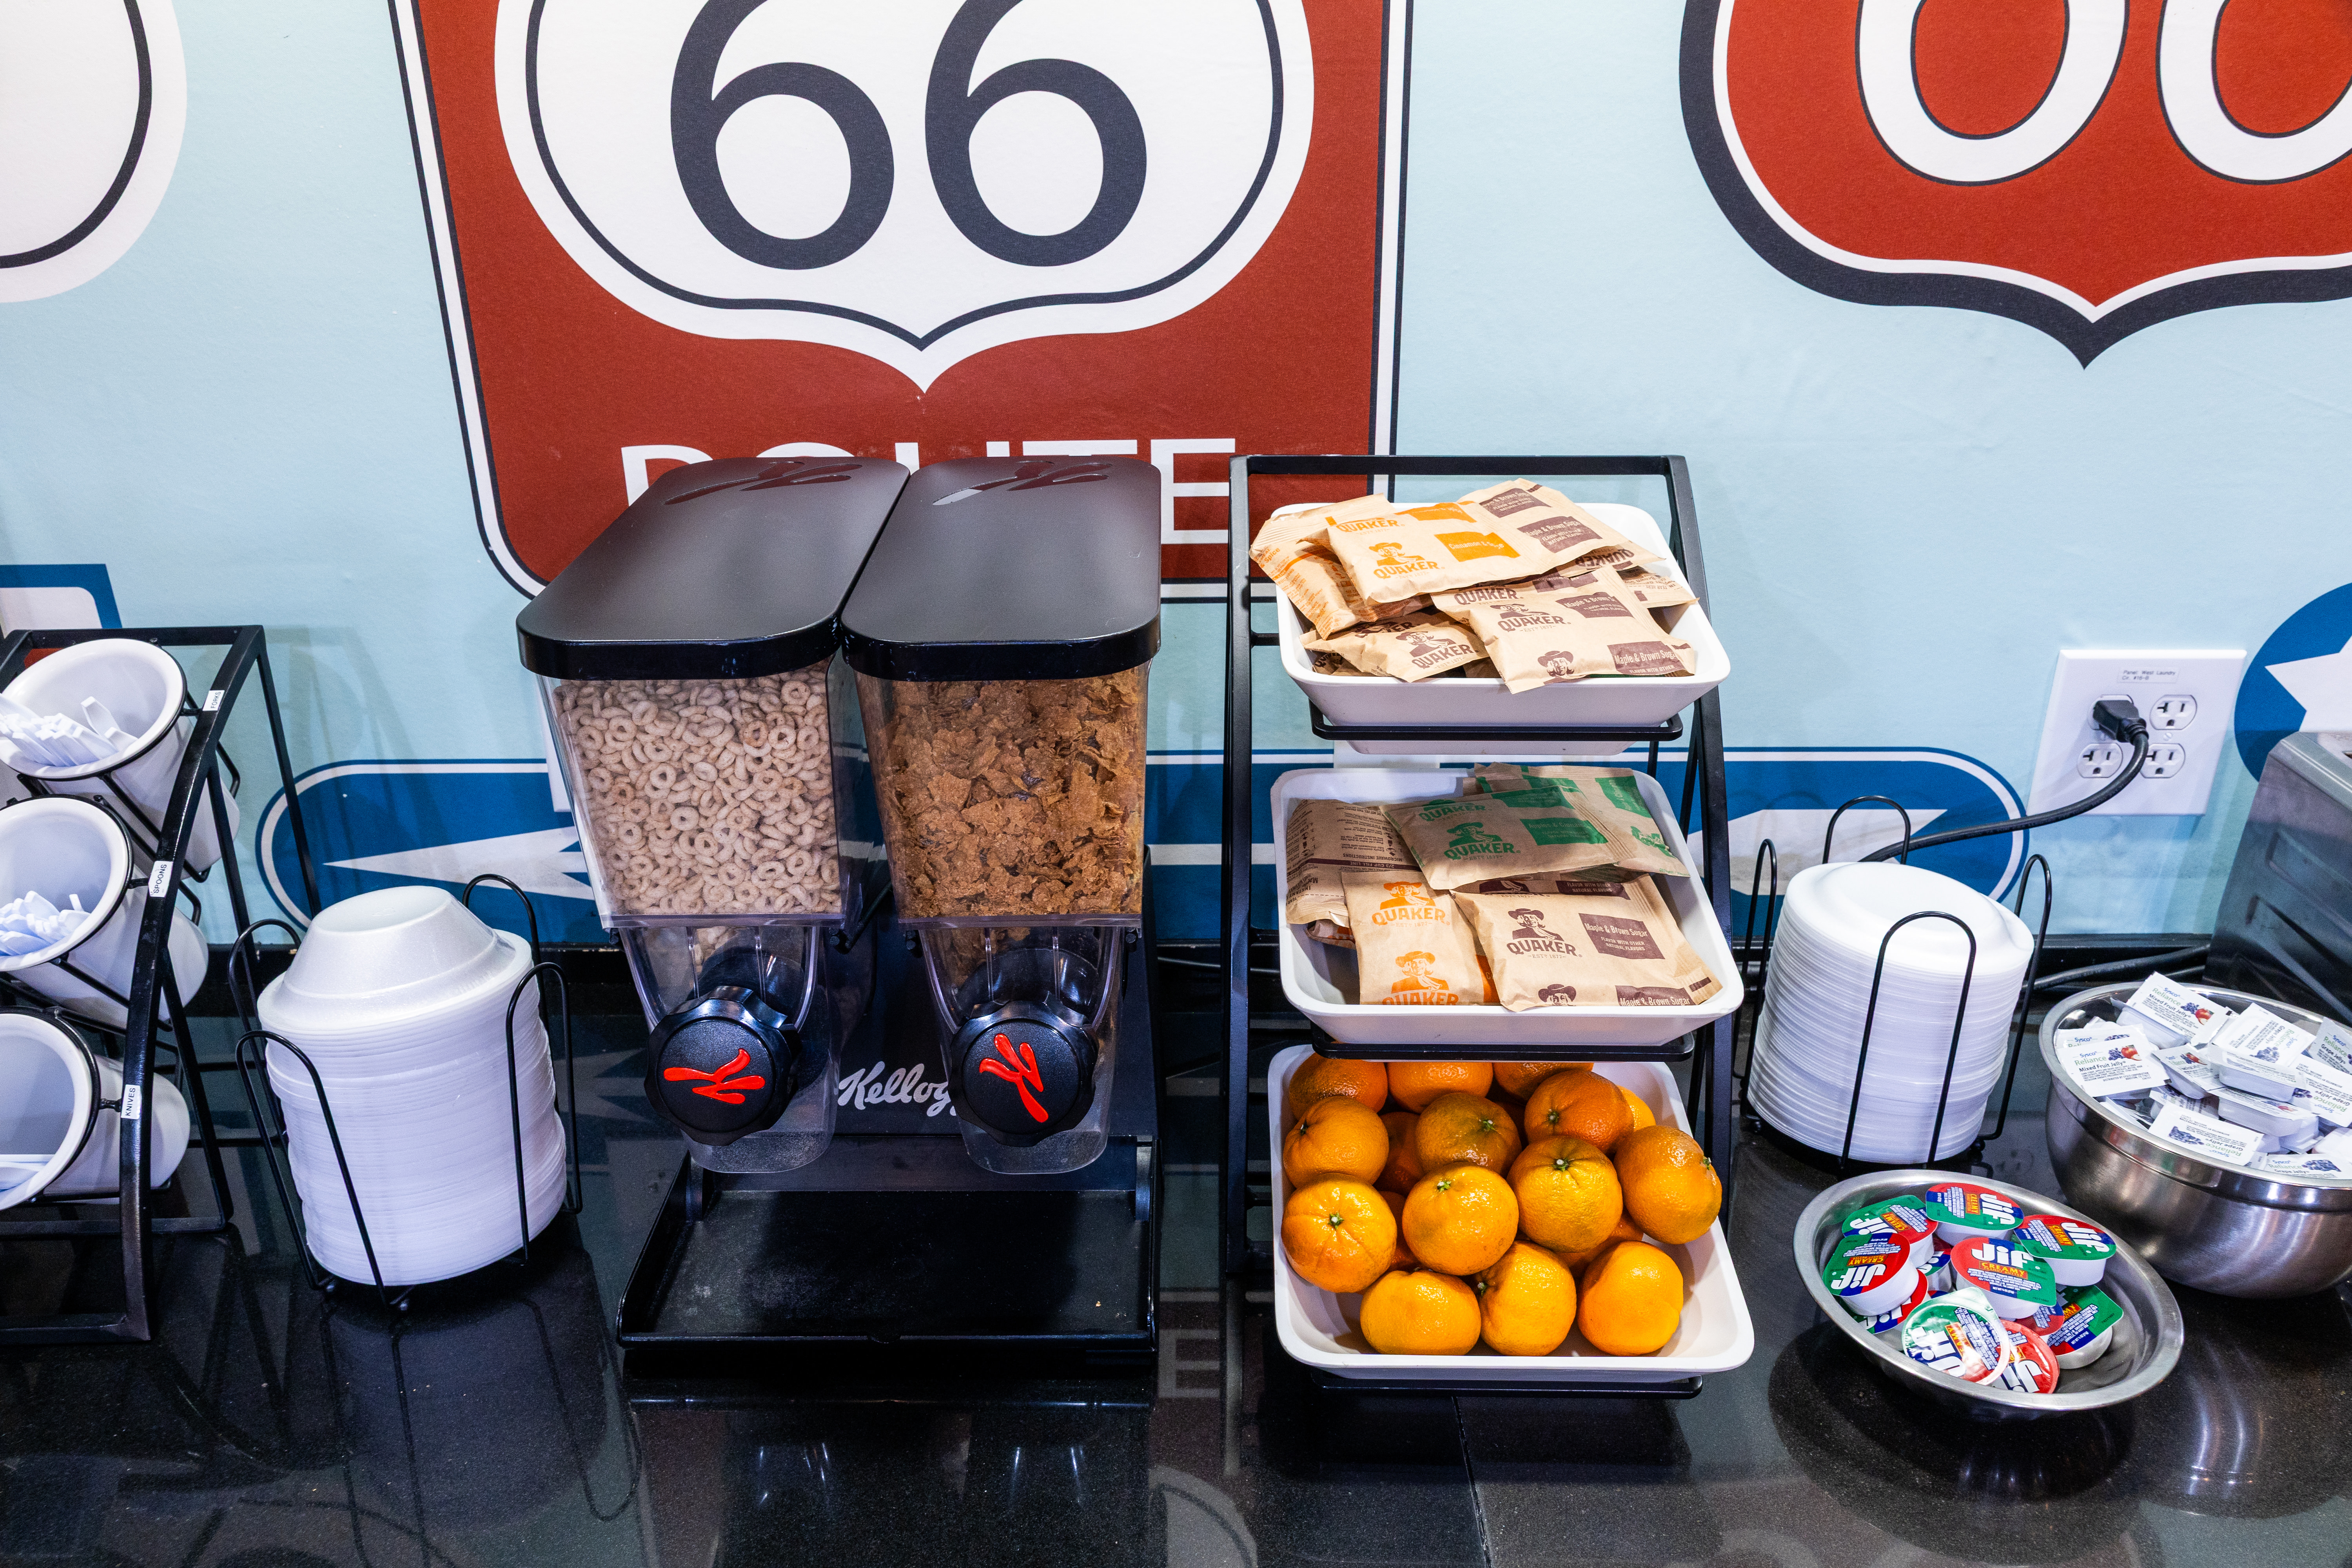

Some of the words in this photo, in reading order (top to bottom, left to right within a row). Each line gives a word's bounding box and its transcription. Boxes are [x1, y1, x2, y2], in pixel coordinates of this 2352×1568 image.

[670, 0, 1147, 270] 66
[1499, 492, 1516, 501] Brown
[1335, 520, 1400, 533] QUAKER
[1547, 523, 1564, 532] Brown
[1448, 541, 1481, 550] Cinnamon
[1548, 536, 1567, 545] NATURAL
[1263, 546, 1281, 564] Spice
[1575, 549, 1635, 567] QUAKER
[1277, 569, 1287, 578] LINE
[1373, 561, 1441, 579] QUAKER
[1454, 588, 1519, 605] QUAKER
[1566, 600, 1584, 608] Maple
[1497, 616, 1565, 632] QUAKER
[1412, 644, 1475, 670] QUAKER
[1451, 657, 1463, 665] 1877
[1614, 653, 1633, 666] Maple
[1635, 653, 1641, 662] &
[1641, 651, 1661, 662] Brown
[210, 691, 221, 709] FORKS
[1418, 805, 1486, 822] QUAKER
[1444, 843, 1517, 860] QUAKER
[153, 864, 167, 893] SPOONS
[1372, 908, 1446, 926] QUAKER
[1585, 922, 1604, 933] Maple
[1610, 925, 1630, 936] Brown
[1630, 927, 1648, 938] Sugar
[1506, 940, 1577, 956] QUAKER
[1382, 992, 1459, 1005] QUAKER
[1620, 997, 1639, 1006] Maple
[1648, 997, 1668, 1006] Brown
[1668, 996, 1690, 1006] Sugar
[2148, 993, 2163, 1004] Mixed
[2163, 1002, 2176, 1011] Fruit
[2152, 987, 2181, 1007] Reliance
[2274, 1025, 2285, 1036] Grape
[2274, 1029, 2294, 1047] Reliance
[2321, 1044, 2334, 1056] Grape
[2323, 1036, 2347, 1057] Reliance
[2074, 1056, 2107, 1065] Reliance
[837, 1061, 957, 1117] Kellog
[125, 1088, 136, 1116] KNIVES
[2314, 1095, 2347, 1111] Reliance
[2332, 1097, 2350, 1106] Grape
[2205, 1142, 2242, 1156] Reliance
[1970, 1194, 1979, 1214] CREAMY
[1980, 1193, 2015, 1225] Jif
[1882, 1214, 1905, 1230] CREAMY
[2052, 1225, 2072, 1245] CREAMY
[2061, 1222, 2110, 1252] Jif
[1848, 1257, 1883, 1265] CREAMY
[1971, 1243, 2034, 1269] Jif
[1830, 1264, 1886, 1290] Jif
[1982, 1262, 2025, 1276] CREAMY
[2084, 1316, 2094, 1324] COMPANY
[1911, 1326, 1966, 1377] Jif
